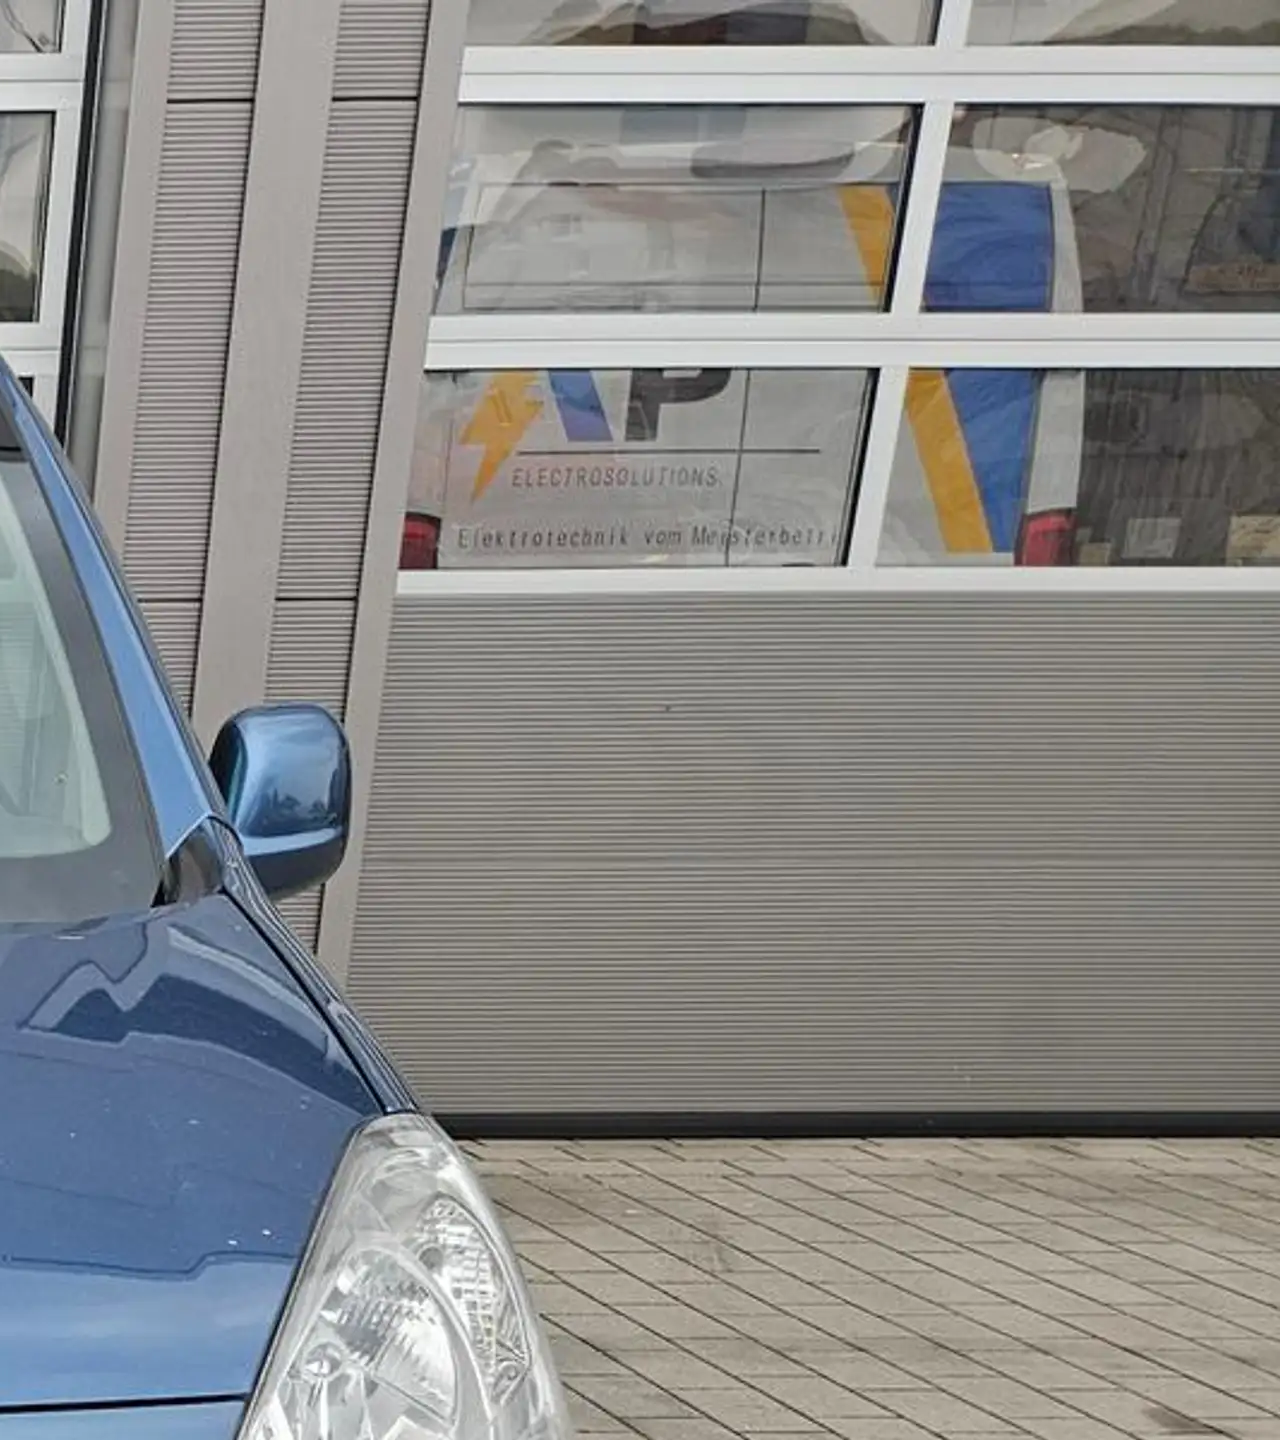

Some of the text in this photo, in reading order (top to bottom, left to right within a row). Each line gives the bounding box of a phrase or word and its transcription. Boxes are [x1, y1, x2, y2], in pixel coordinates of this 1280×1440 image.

[511, 466, 720, 488] ELECTROSOLUTIONS
[457, 525, 837, 549] Elektrotechnik vom Meisterbetri
